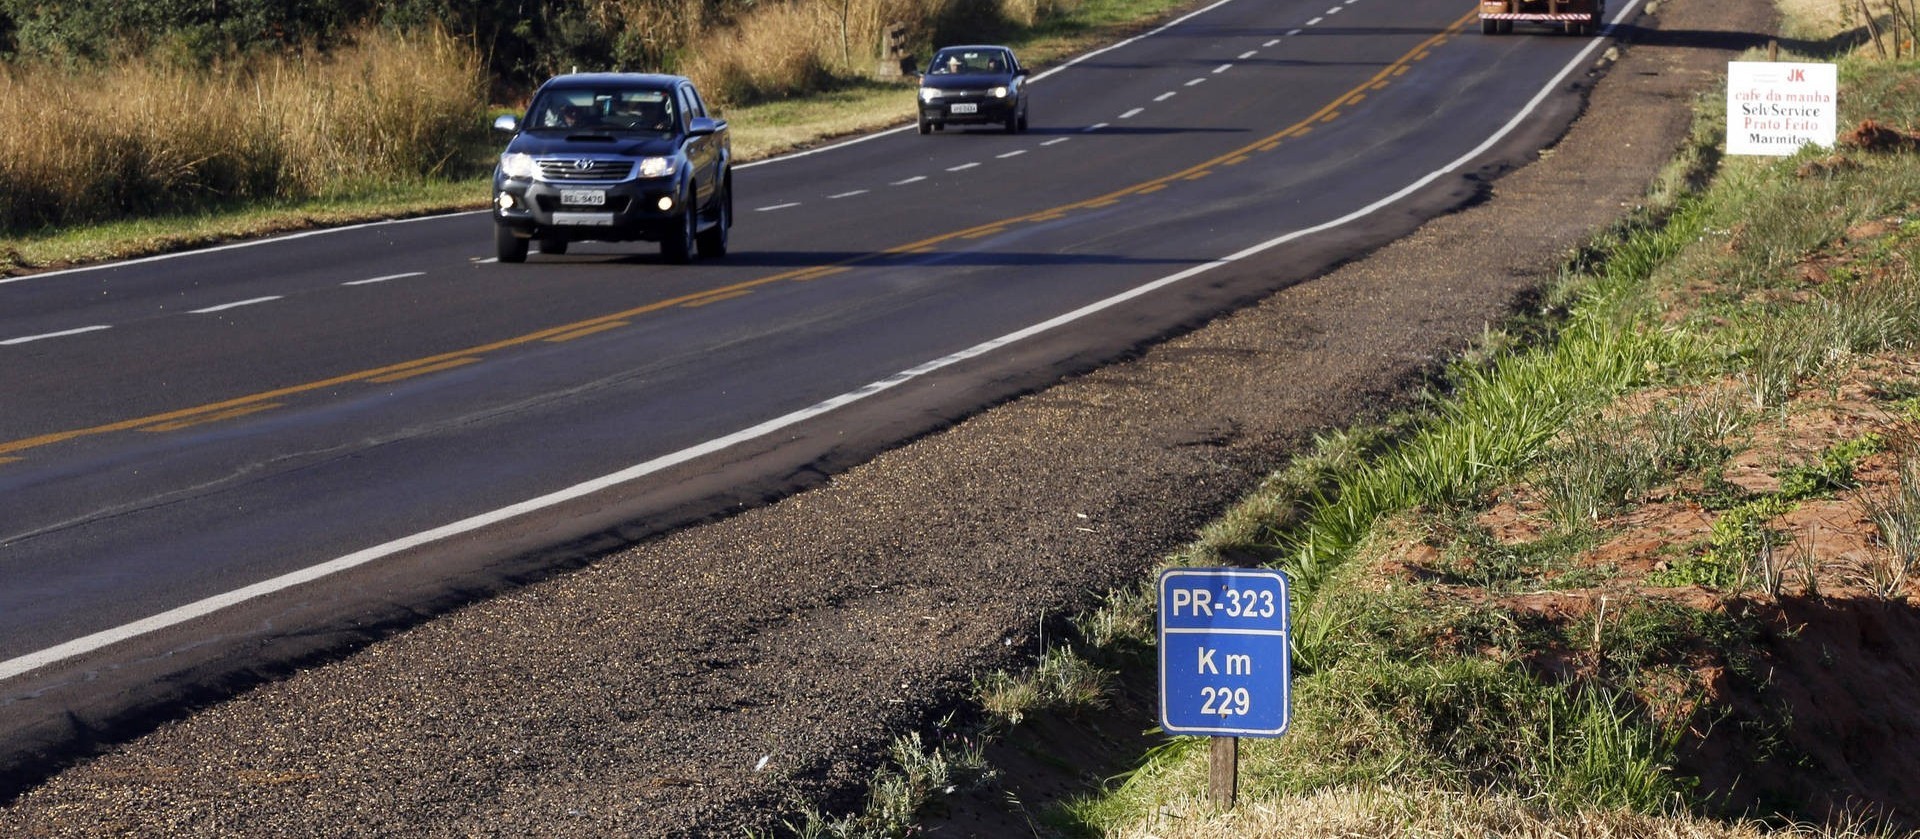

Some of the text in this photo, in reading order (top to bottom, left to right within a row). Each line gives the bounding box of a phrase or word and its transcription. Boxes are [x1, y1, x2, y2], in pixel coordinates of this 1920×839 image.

[1787, 68, 1805, 82] JK
[1766, 88, 1781, 102] da
[1771, 103, 1820, 117] Service
[1744, 117, 1818, 130] Prato Feito
[1173, 588, 1275, 618] PR-323
[1200, 686, 1250, 716] 229
